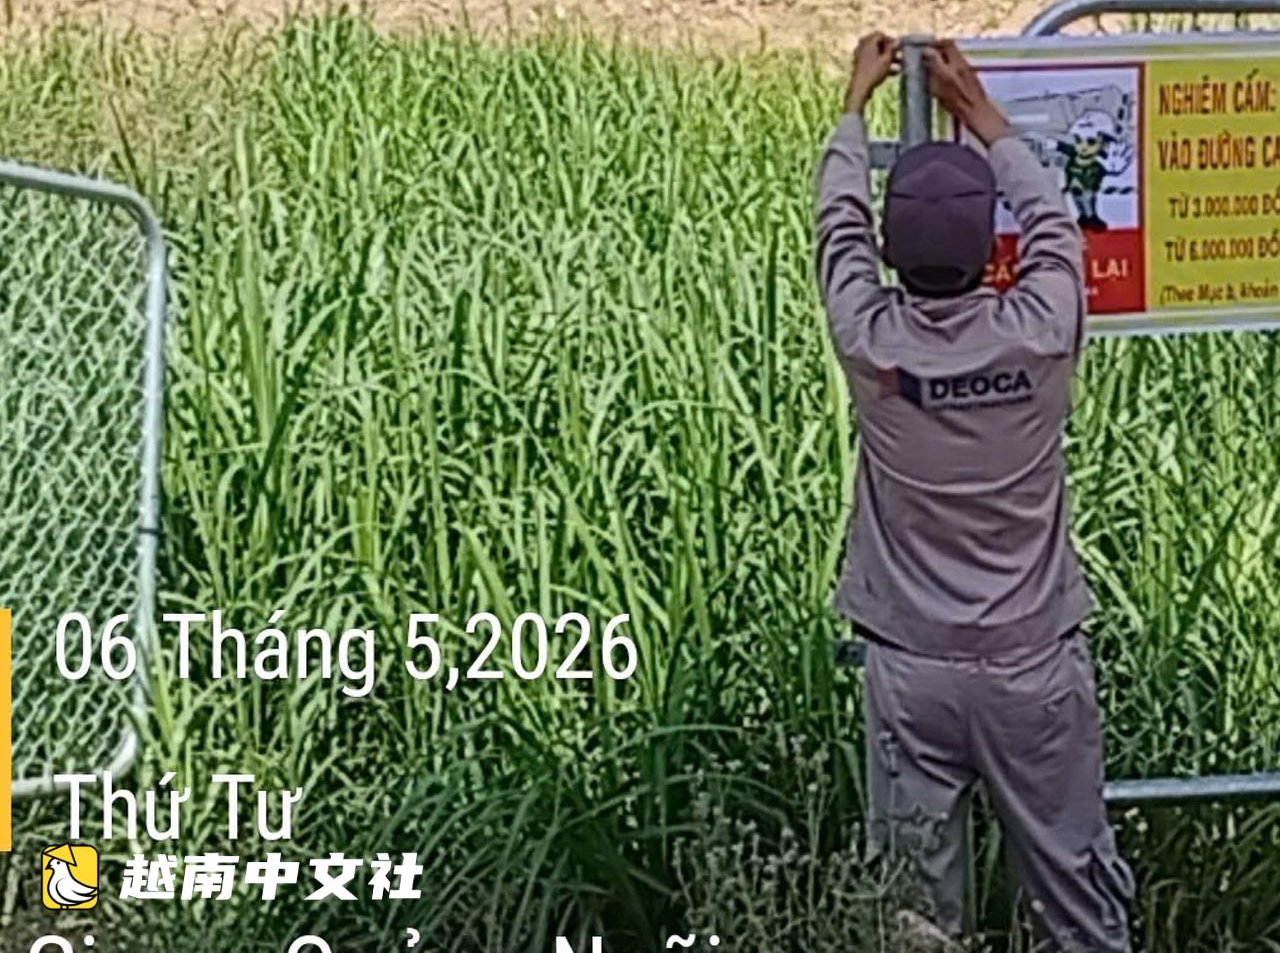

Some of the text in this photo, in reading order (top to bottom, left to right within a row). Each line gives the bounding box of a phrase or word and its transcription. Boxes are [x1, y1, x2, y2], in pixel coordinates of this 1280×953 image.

[1158, 74, 1227, 116] NGHIÊM
[1232, 68, 1277, 113] CẤM:
[1158, 130, 1192, 171] VÀO
[1197, 129, 1256, 171] ĐƯỜNG
[1168, 192, 1189, 219] TỪ
[1165, 235, 1187, 262] TỪ
[1091, 259, 1129, 282] LẠI
[929, 369, 1032, 400] DEOCA
